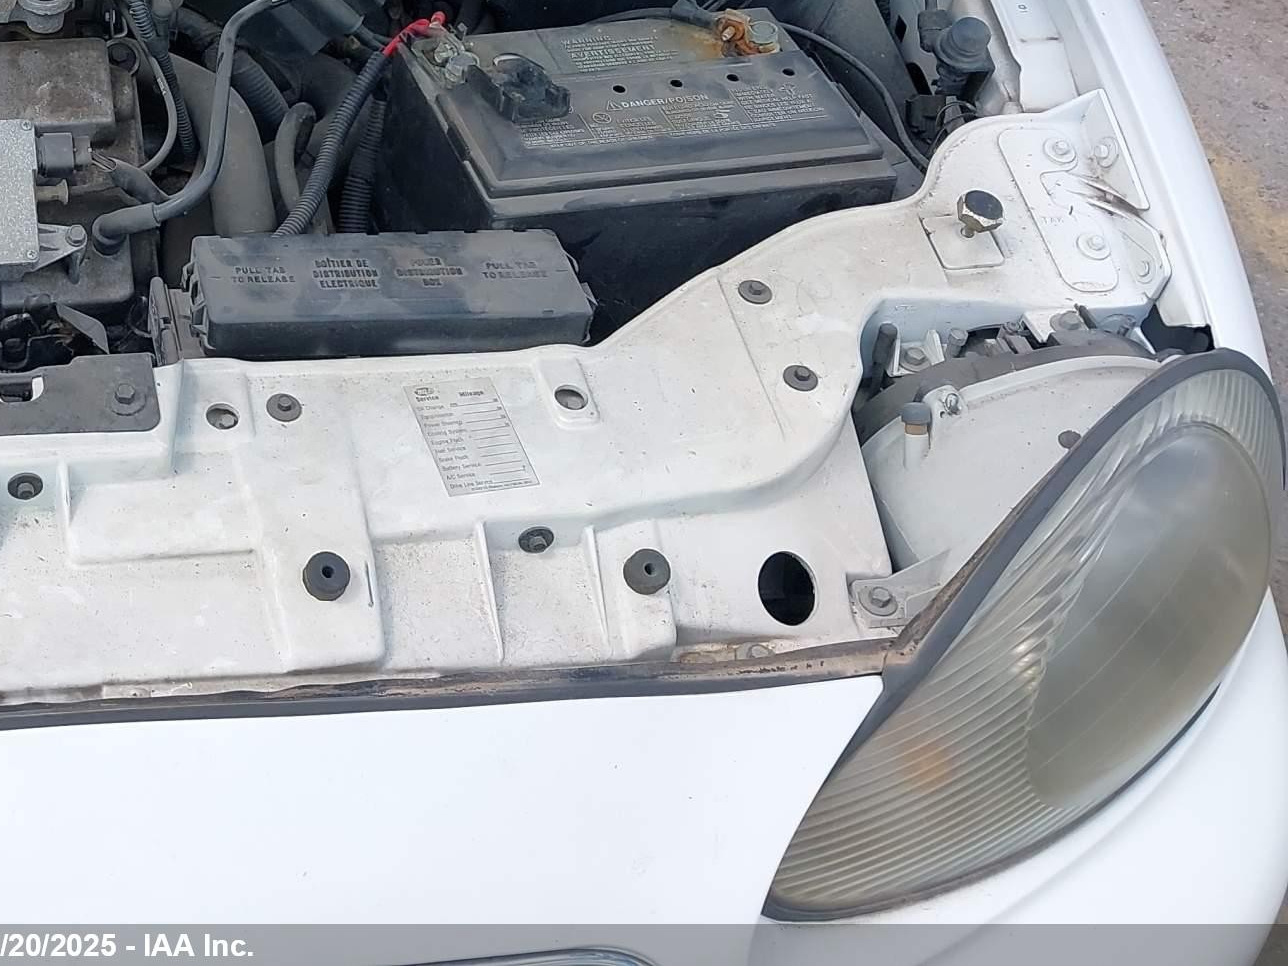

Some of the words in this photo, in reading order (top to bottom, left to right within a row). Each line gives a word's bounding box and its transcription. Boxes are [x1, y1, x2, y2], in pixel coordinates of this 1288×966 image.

[357, 259, 369, 268] DE
[486, 262, 512, 270] PULL
[235, 266, 261, 274] PULL
[265, 266, 286, 274] TAB
[313, 269, 378, 278] DISTRIBUTION
[396, 267, 463, 277] DISTRIBUTION
[498, 270, 549, 278] RELEASE
